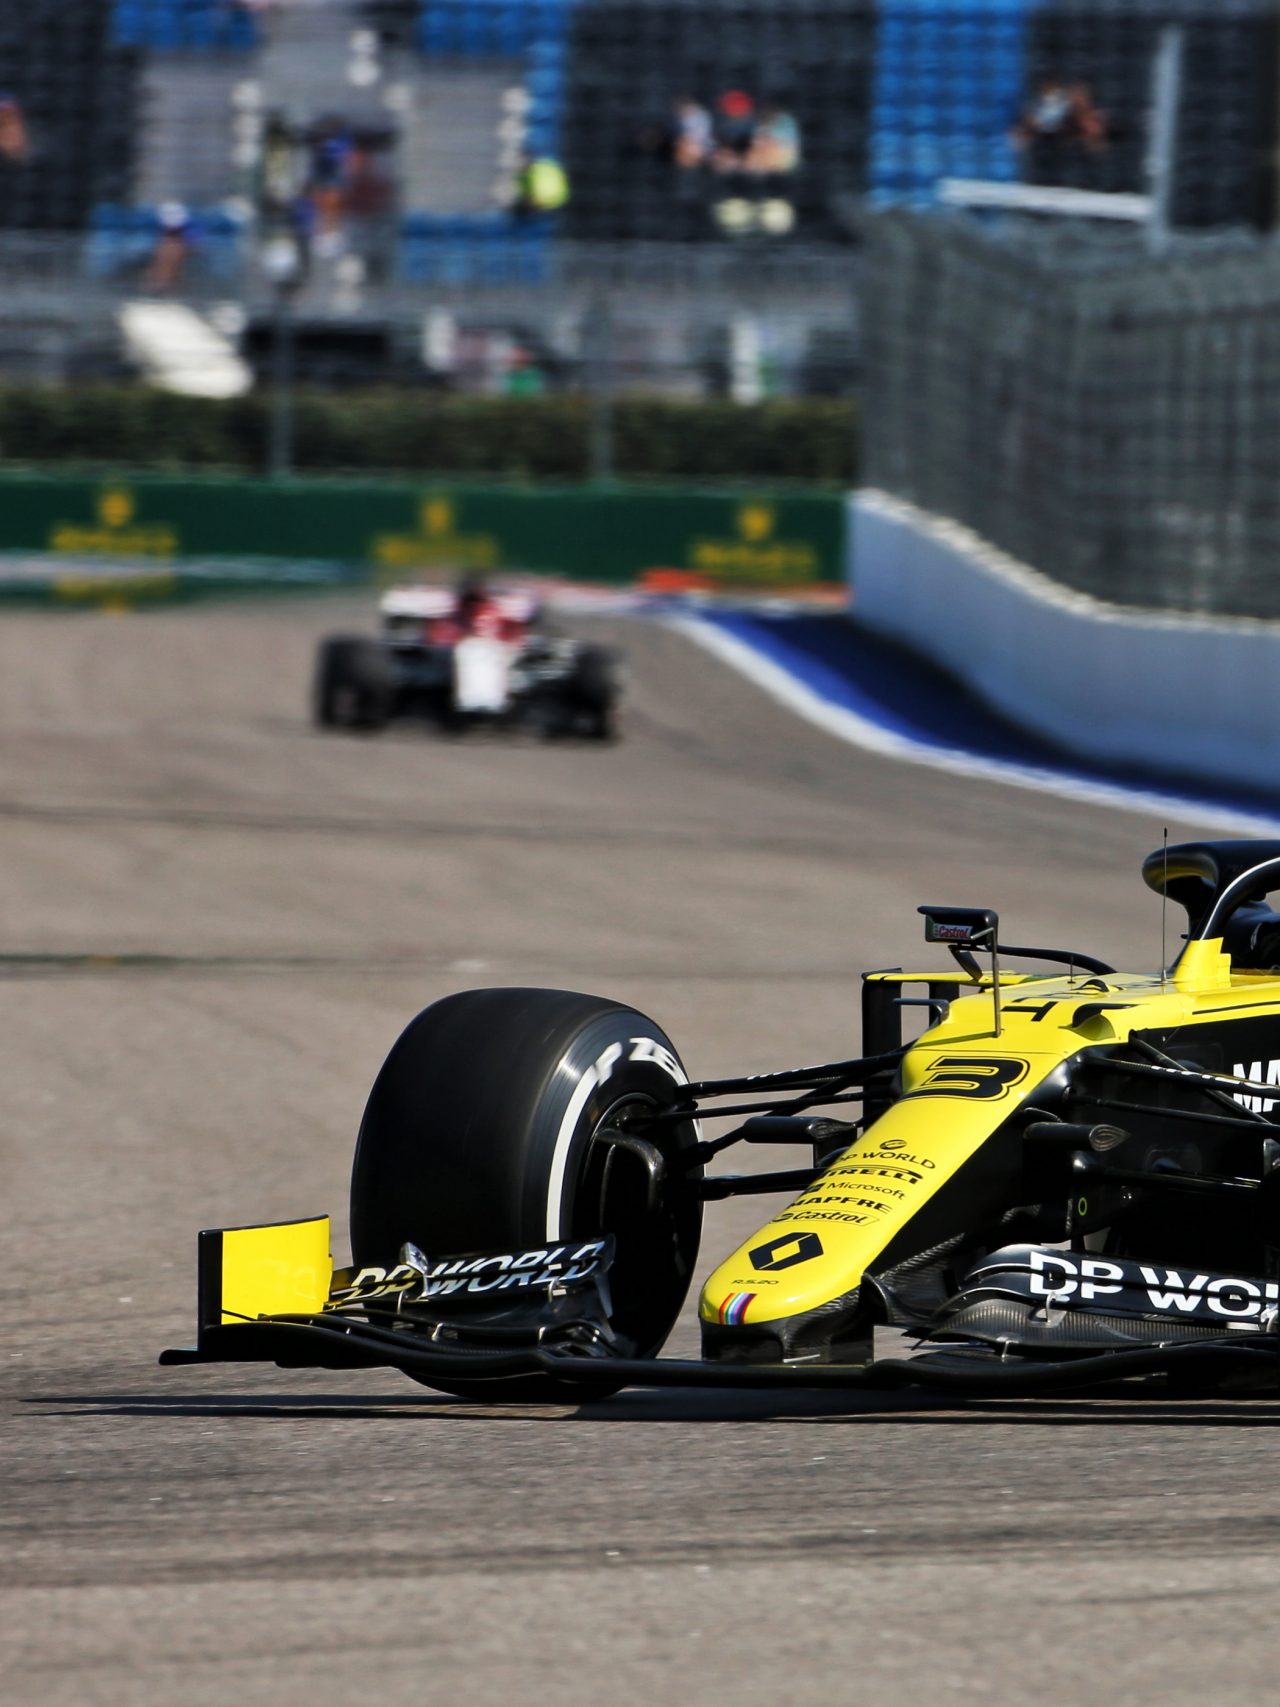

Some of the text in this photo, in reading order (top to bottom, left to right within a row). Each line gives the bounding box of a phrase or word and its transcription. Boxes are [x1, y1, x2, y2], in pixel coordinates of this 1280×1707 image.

[900, 1056, 1030, 1101] 3
[863, 1152, 935, 1169] WORLD
[827, 1182, 906, 1200] Microsoft
[793, 1211, 869, 1223] Castrol
[1029, 1251, 1124, 1301] DP
